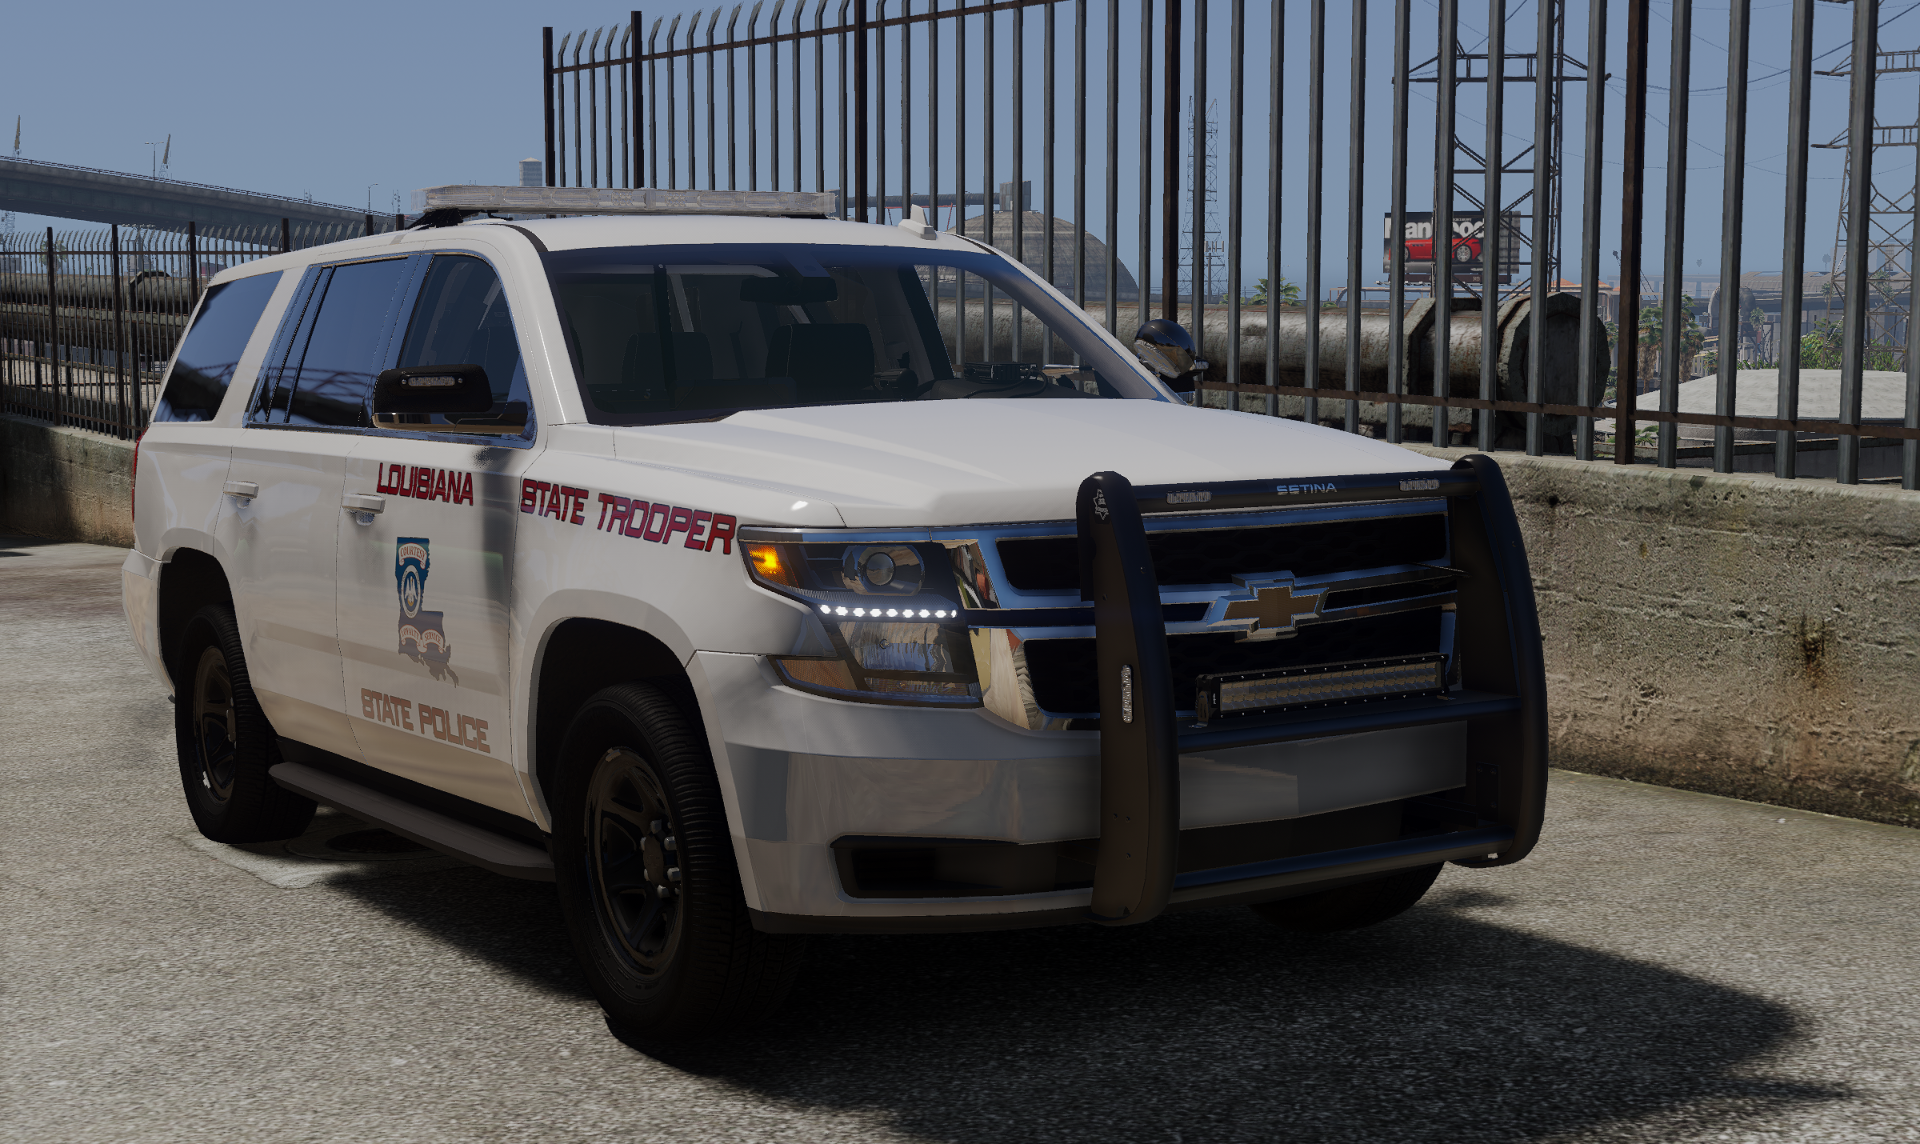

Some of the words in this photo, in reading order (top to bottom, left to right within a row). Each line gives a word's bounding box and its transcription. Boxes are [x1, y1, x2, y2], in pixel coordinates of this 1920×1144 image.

[376, 462, 474, 506] LOUISIANA
[1276, 482, 1338, 496] SETINA
[520, 478, 590, 526] STATE
[597, 492, 738, 555] TROOPER
[400, 545, 427, 561] COURTESY
[361, 688, 414, 732] STATE
[418, 703, 491, 754] POLICE
